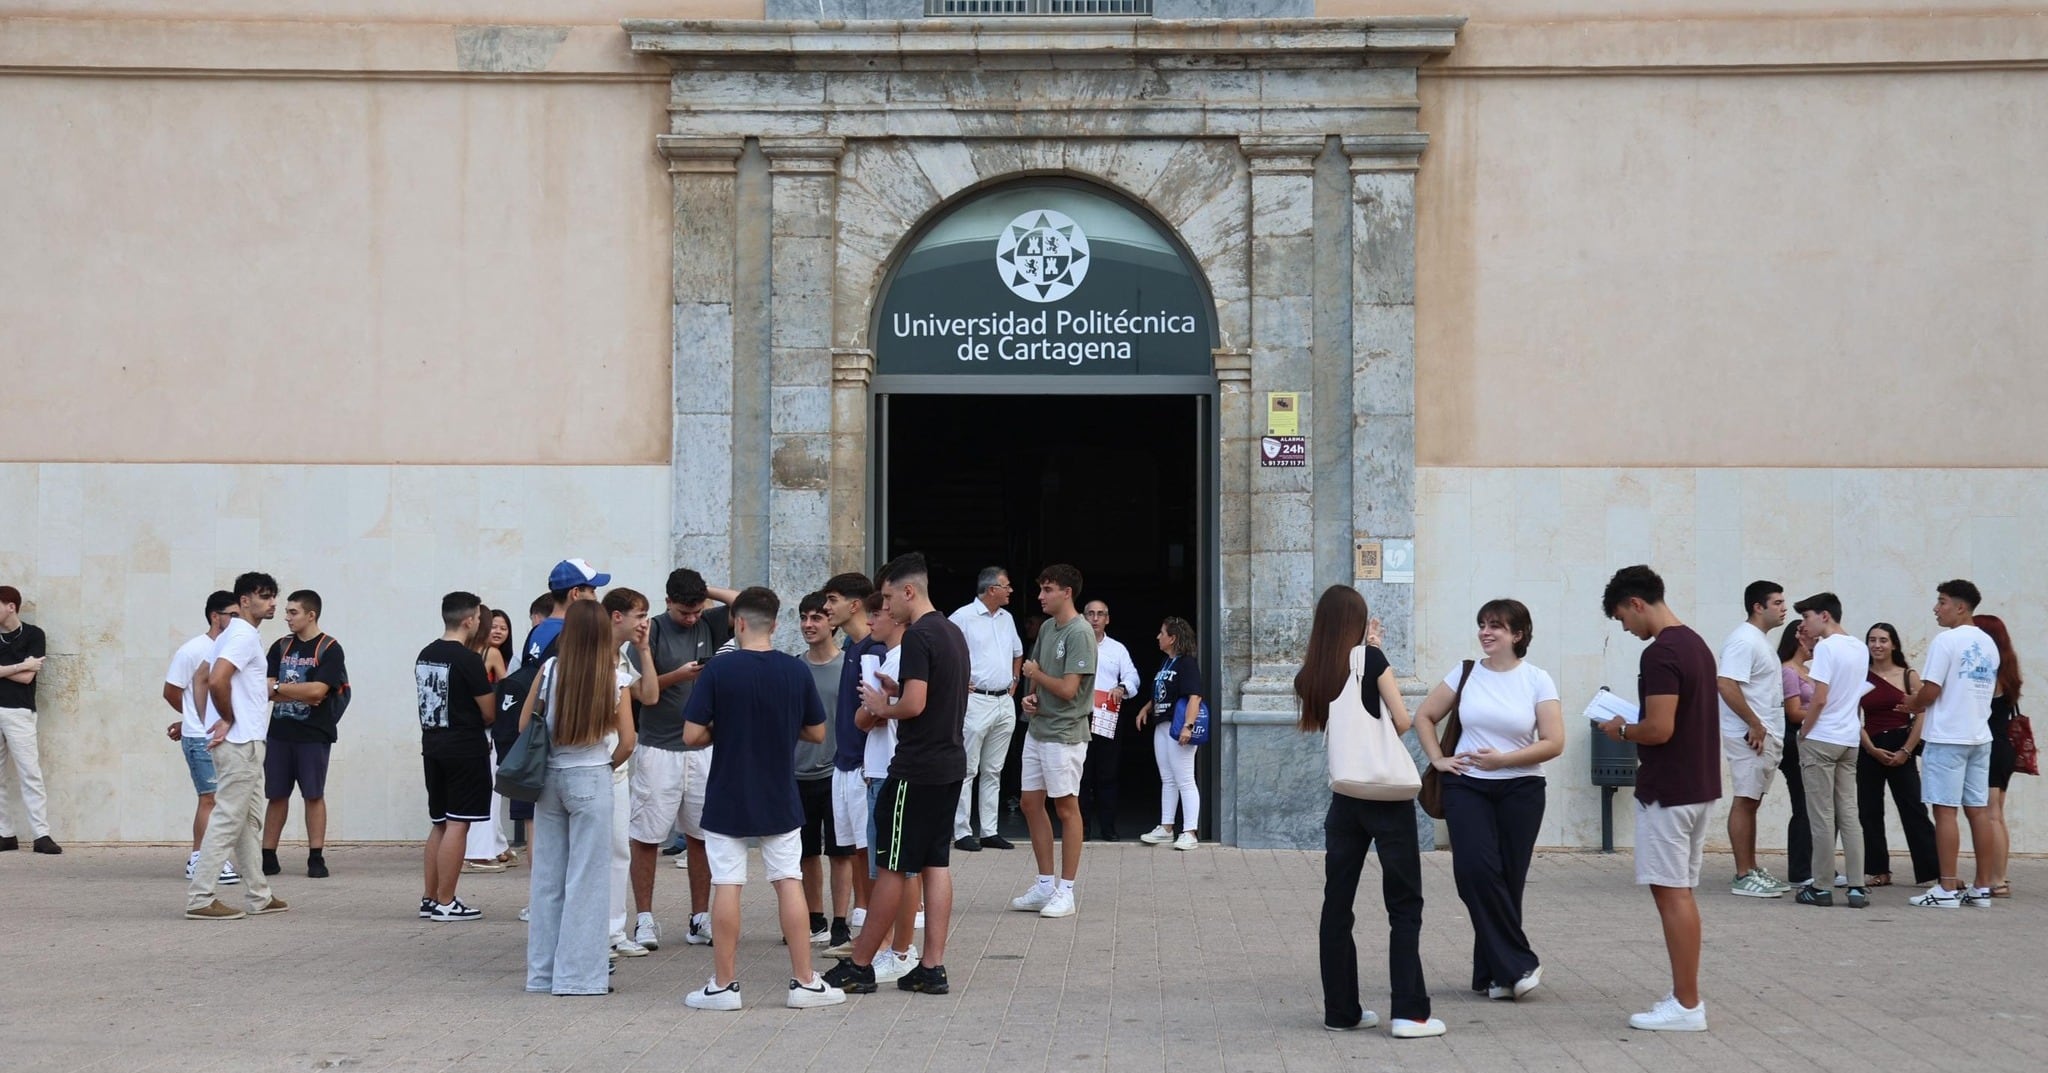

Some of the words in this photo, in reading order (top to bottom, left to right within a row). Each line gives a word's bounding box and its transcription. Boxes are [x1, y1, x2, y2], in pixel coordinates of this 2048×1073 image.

[893, 311, 1046, 337] Universidad
[1057, 309, 1196, 334] Politécnica
[957, 337, 989, 361] de
[998, 336, 1131, 366] Cartagena
[1283, 444, 1304, 453] 24h
